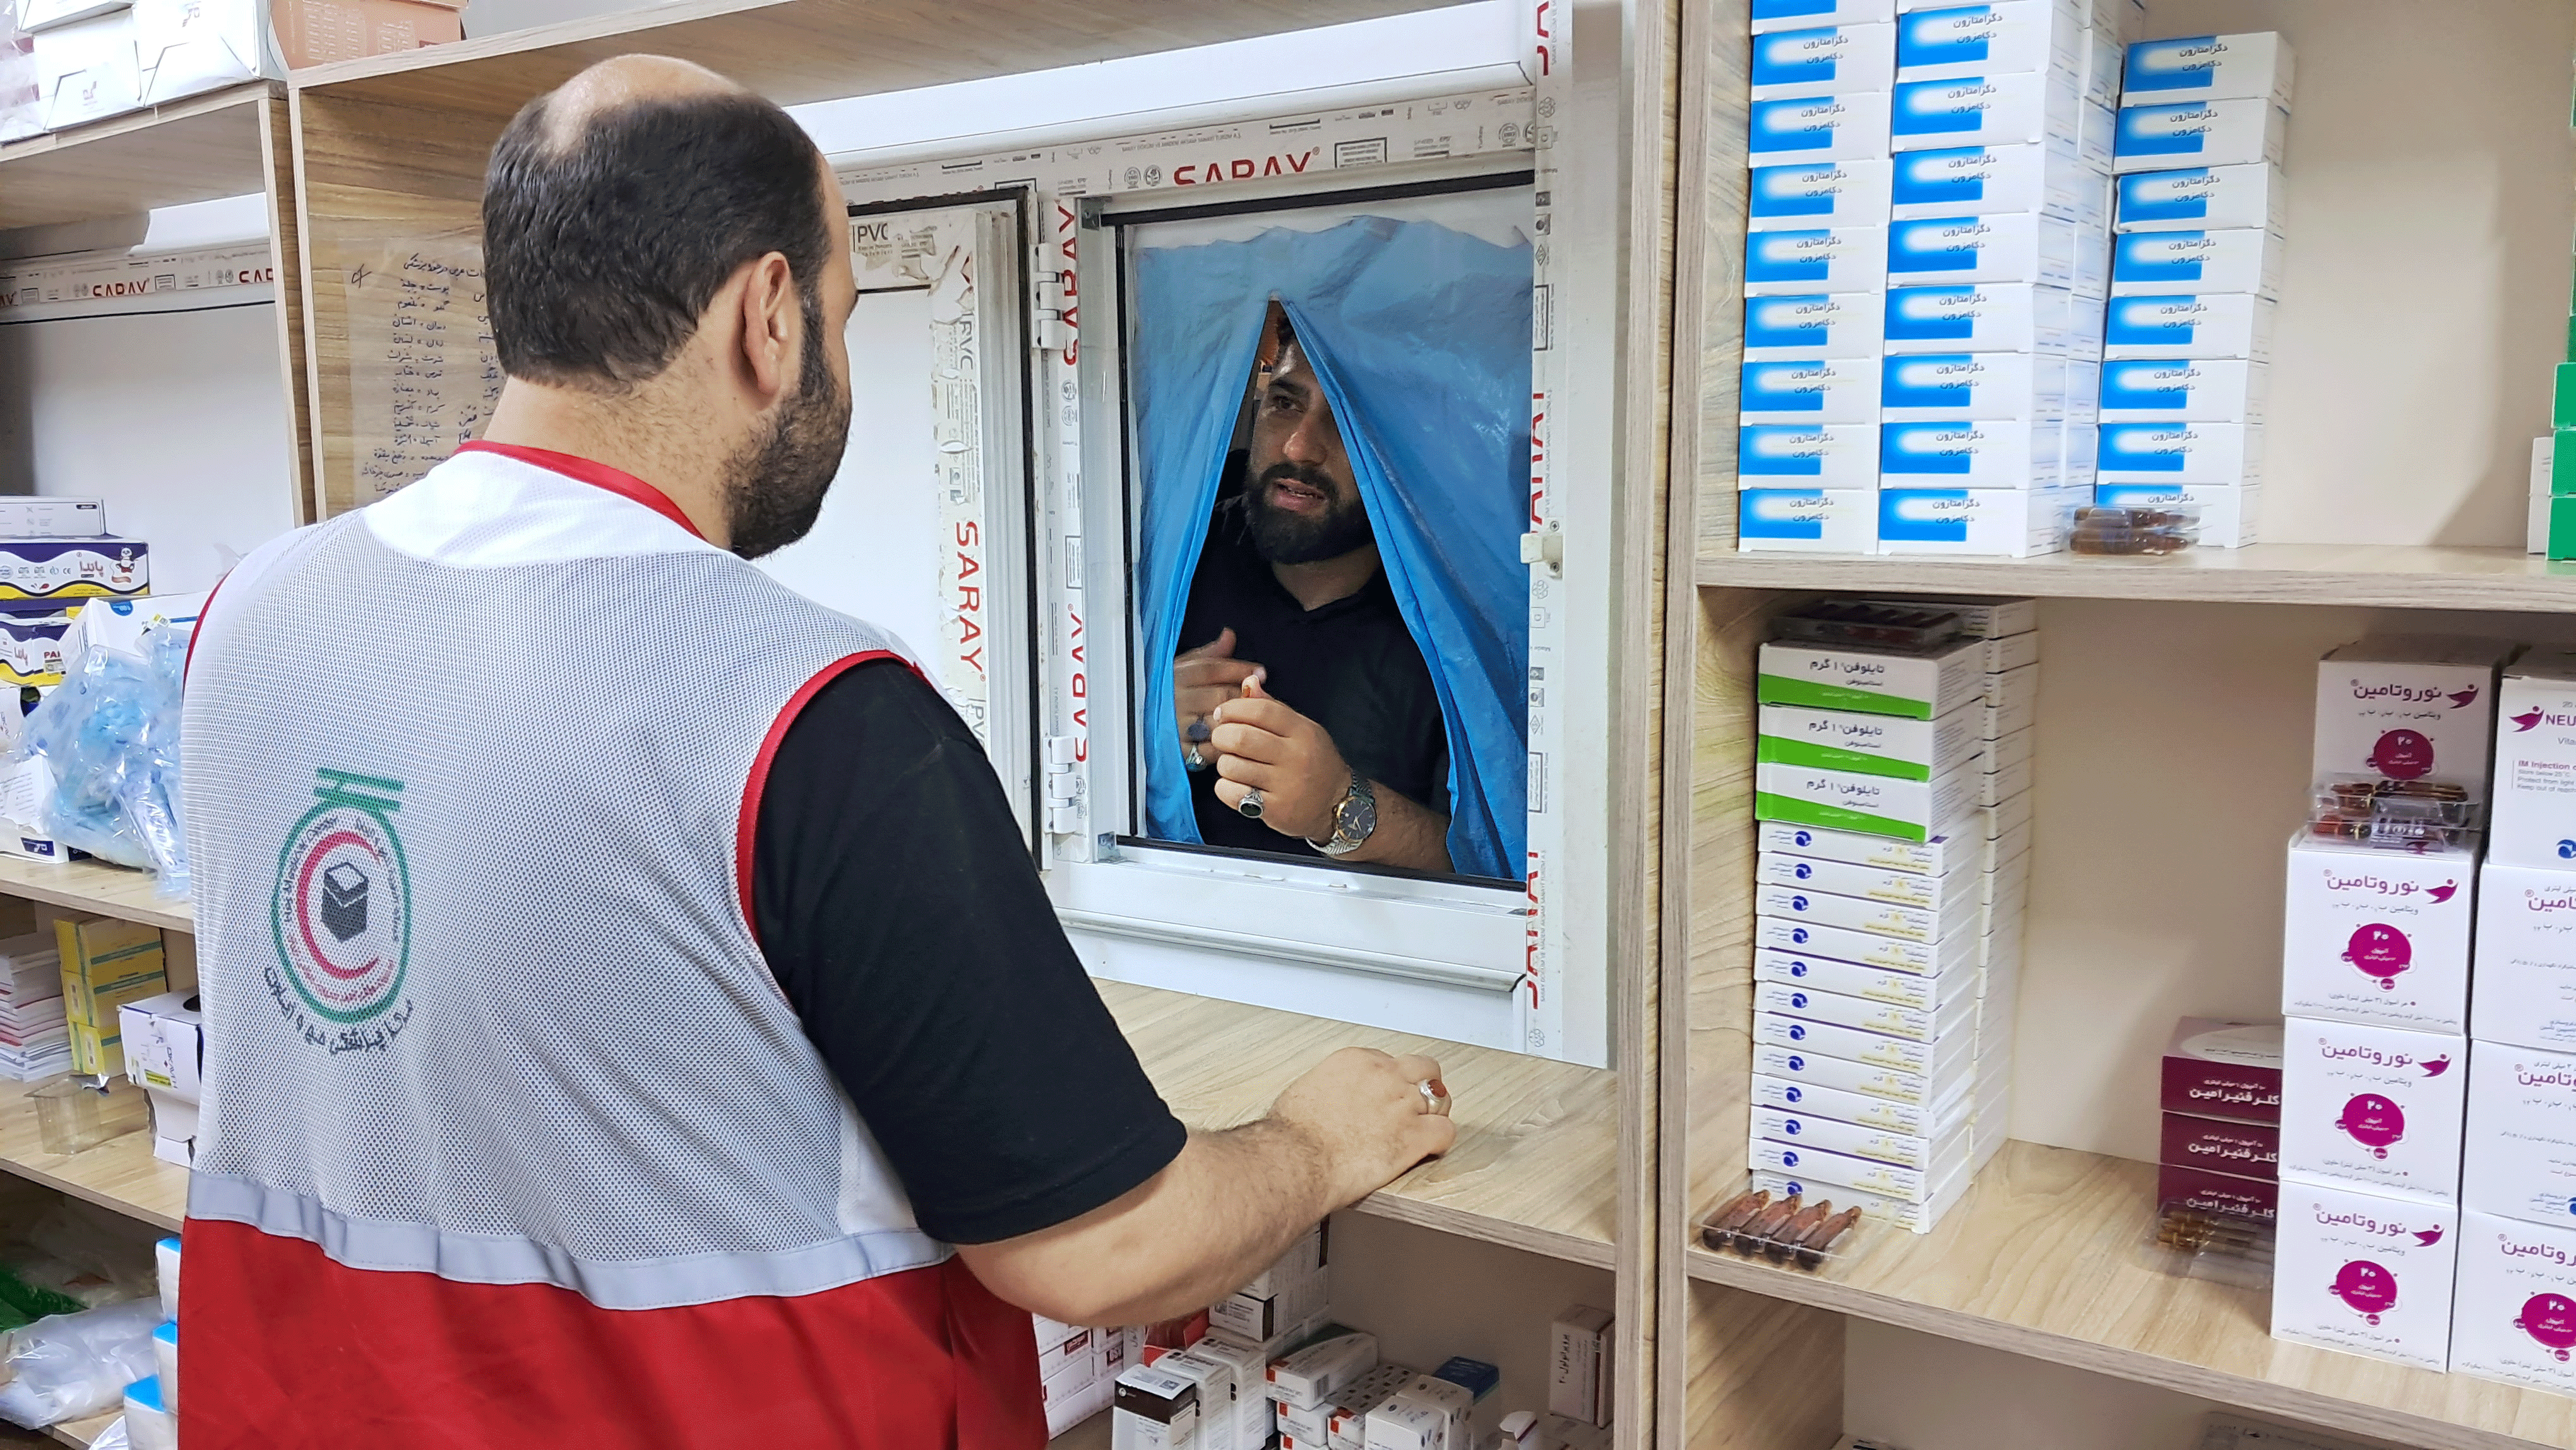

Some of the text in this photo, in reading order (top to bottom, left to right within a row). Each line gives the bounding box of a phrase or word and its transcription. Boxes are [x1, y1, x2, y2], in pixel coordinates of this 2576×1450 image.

[956, 522, 983, 673] SARAY
[1810, 659, 1830, 670] گرم
[2353, 685, 2442, 702] نوروتامین
[1809, 721, 1828, 731] گرم
[2546, 715, 2576, 726] NEU
[2532, 761, 2570, 770] Injection
[1807, 779, 1826, 789] گرم
[2327, 876, 2419, 896] نوروتامین
[329, 1028, 386, 1055] پزشکی
[2322, 1046, 2413, 1068] نوروتامین
[2190, 1089, 2279, 1105] کلرفنیرامین
[2188, 1143, 2277, 1163] کلرفنیرامین
[2186, 1199, 2275, 1218] کلرفنیرامین
[2316, 1211, 2407, 1237] نوروتامین
